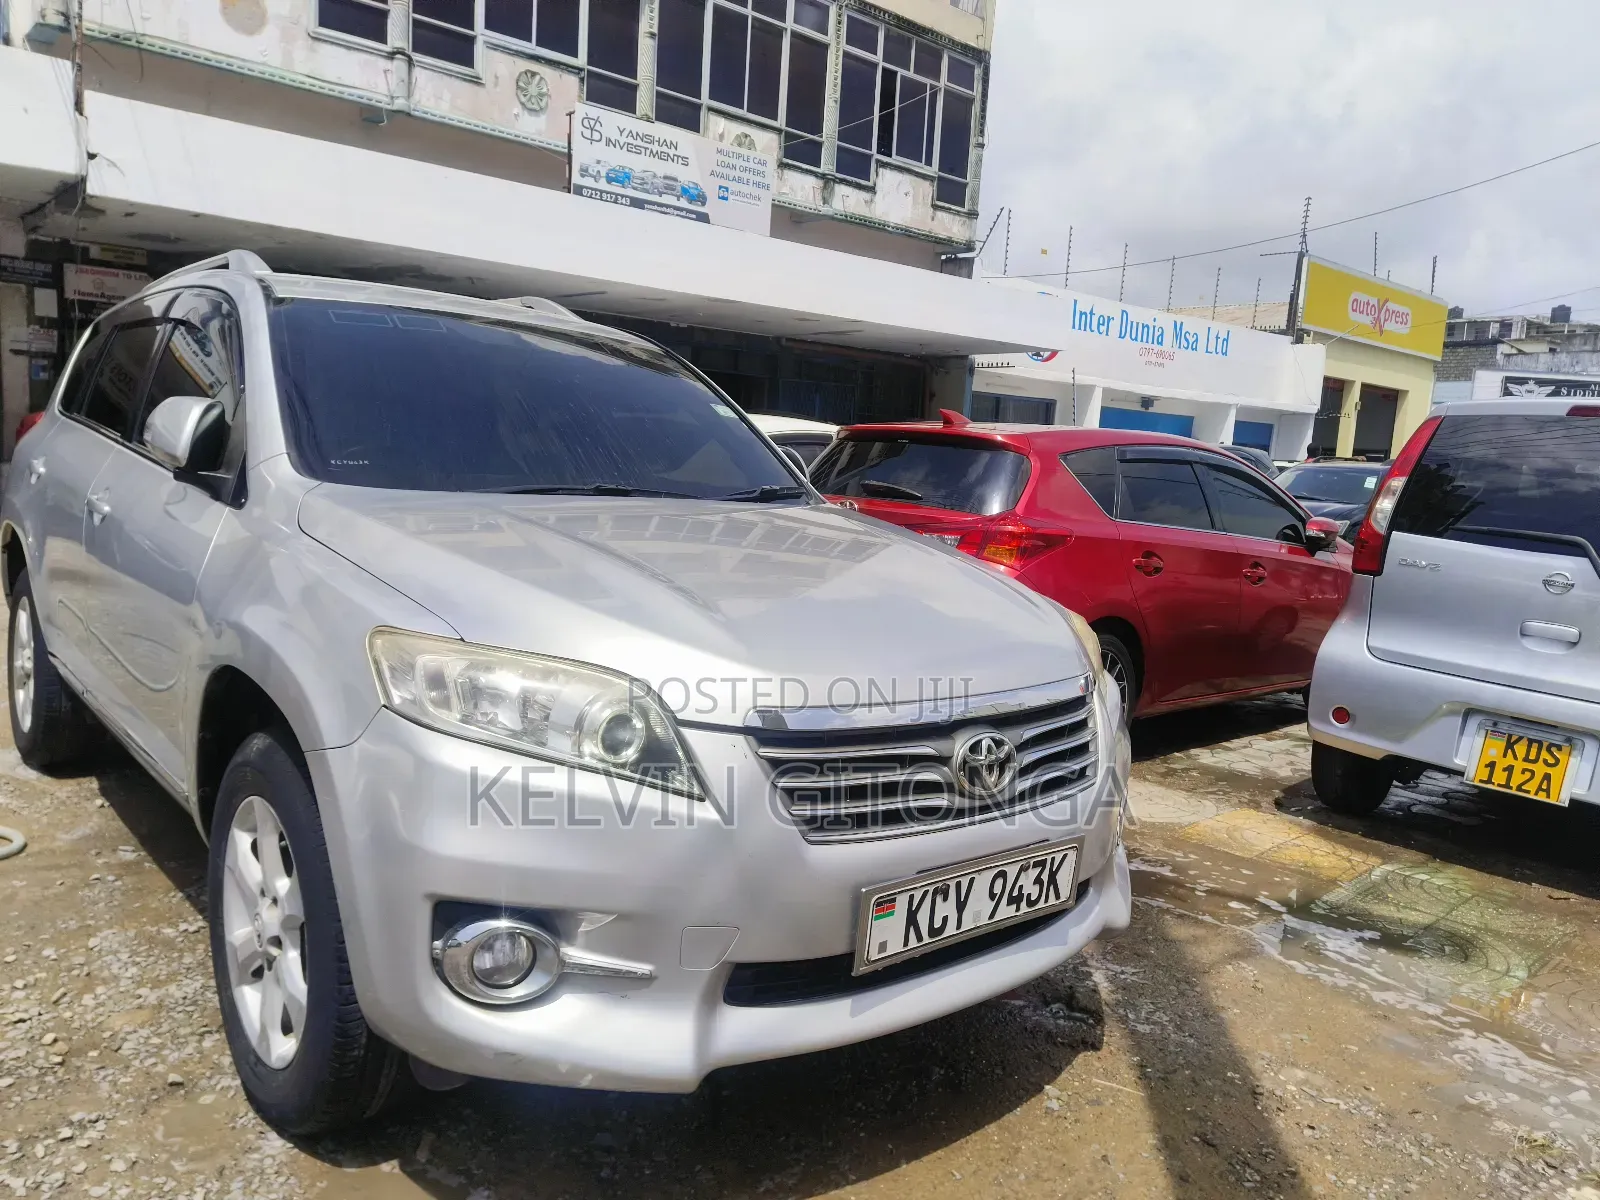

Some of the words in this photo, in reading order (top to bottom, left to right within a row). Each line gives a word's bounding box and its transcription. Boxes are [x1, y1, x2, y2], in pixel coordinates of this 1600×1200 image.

[617, 125, 678, 151] YANSHAN
[605, 136, 689, 167] INVESTMENTS
[716, 147, 751, 163] MULTIPLE
[752, 157, 768, 168] CAR
[709, 169, 751, 186] AVAILABLE
[752, 180, 771, 191] HERE
[716, 159, 737, 171] LOAN
[738, 165, 766, 179] OFFERS
[582, 188, 601, 199] 0712
[602, 193, 616, 202] 917
[616, 196, 631, 205] 343
[730, 189, 762, 202] autochek
[1072, 299, 1115, 336] Inter
[1118, 309, 1165, 346] Dunia
[1171, 320, 1199, 351] Msa
[1205, 327, 1231, 356] Ltd
[1502, 733, 1563, 769] KDS
[1479, 760, 1553, 799] 112A
[903, 877, 976, 948] KCY
[987, 853, 1069, 921] 943K
